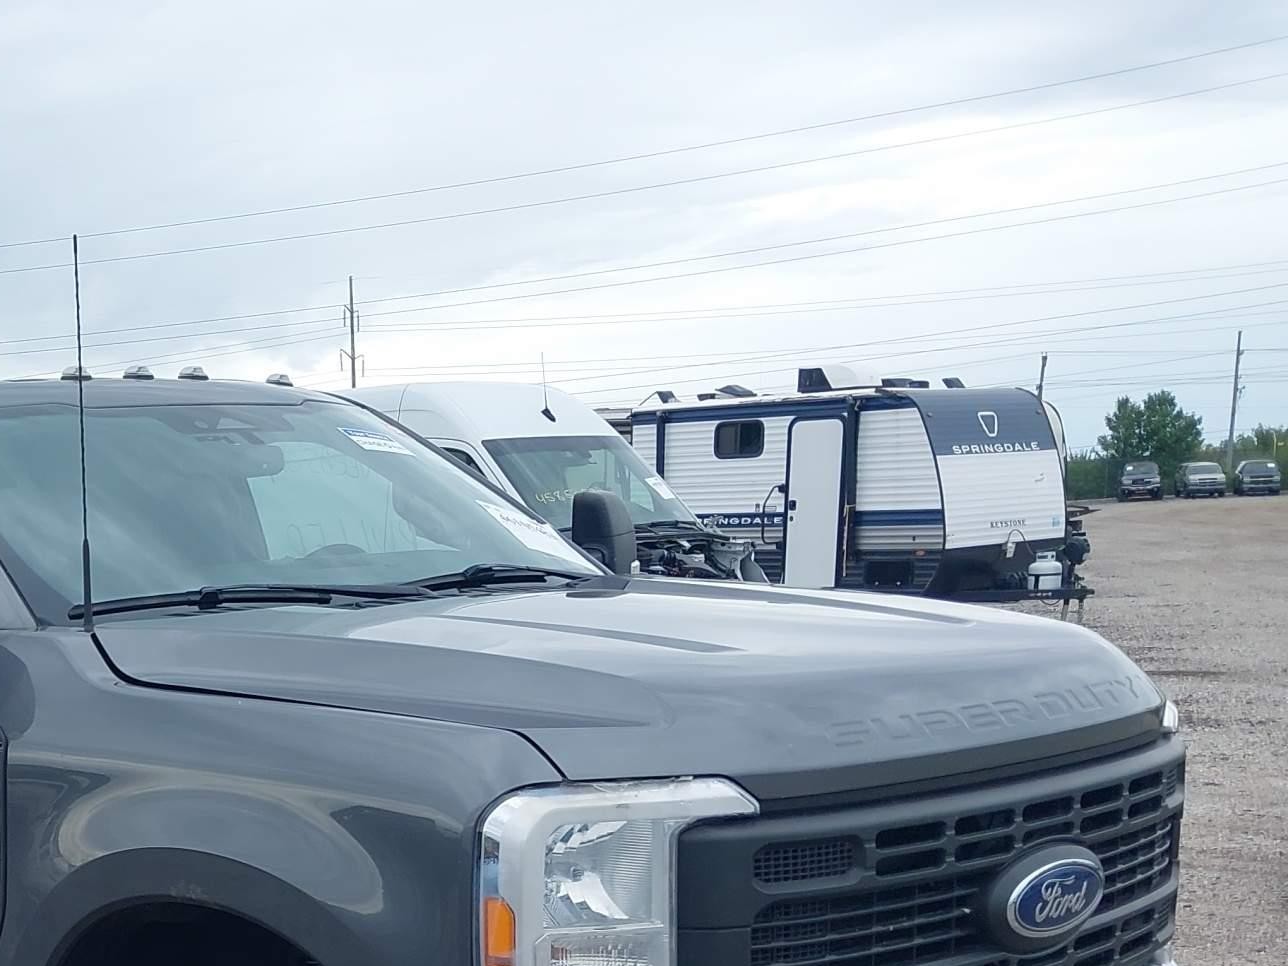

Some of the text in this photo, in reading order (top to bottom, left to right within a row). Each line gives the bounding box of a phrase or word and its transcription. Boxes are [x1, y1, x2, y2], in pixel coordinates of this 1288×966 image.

[952, 441, 1040, 454] SPRINGDALE
[990, 519, 1027, 529] KEYSTONE
[826, 675, 1144, 748] SUPER DUTY
[1035, 875, 1088, 923] Ford
